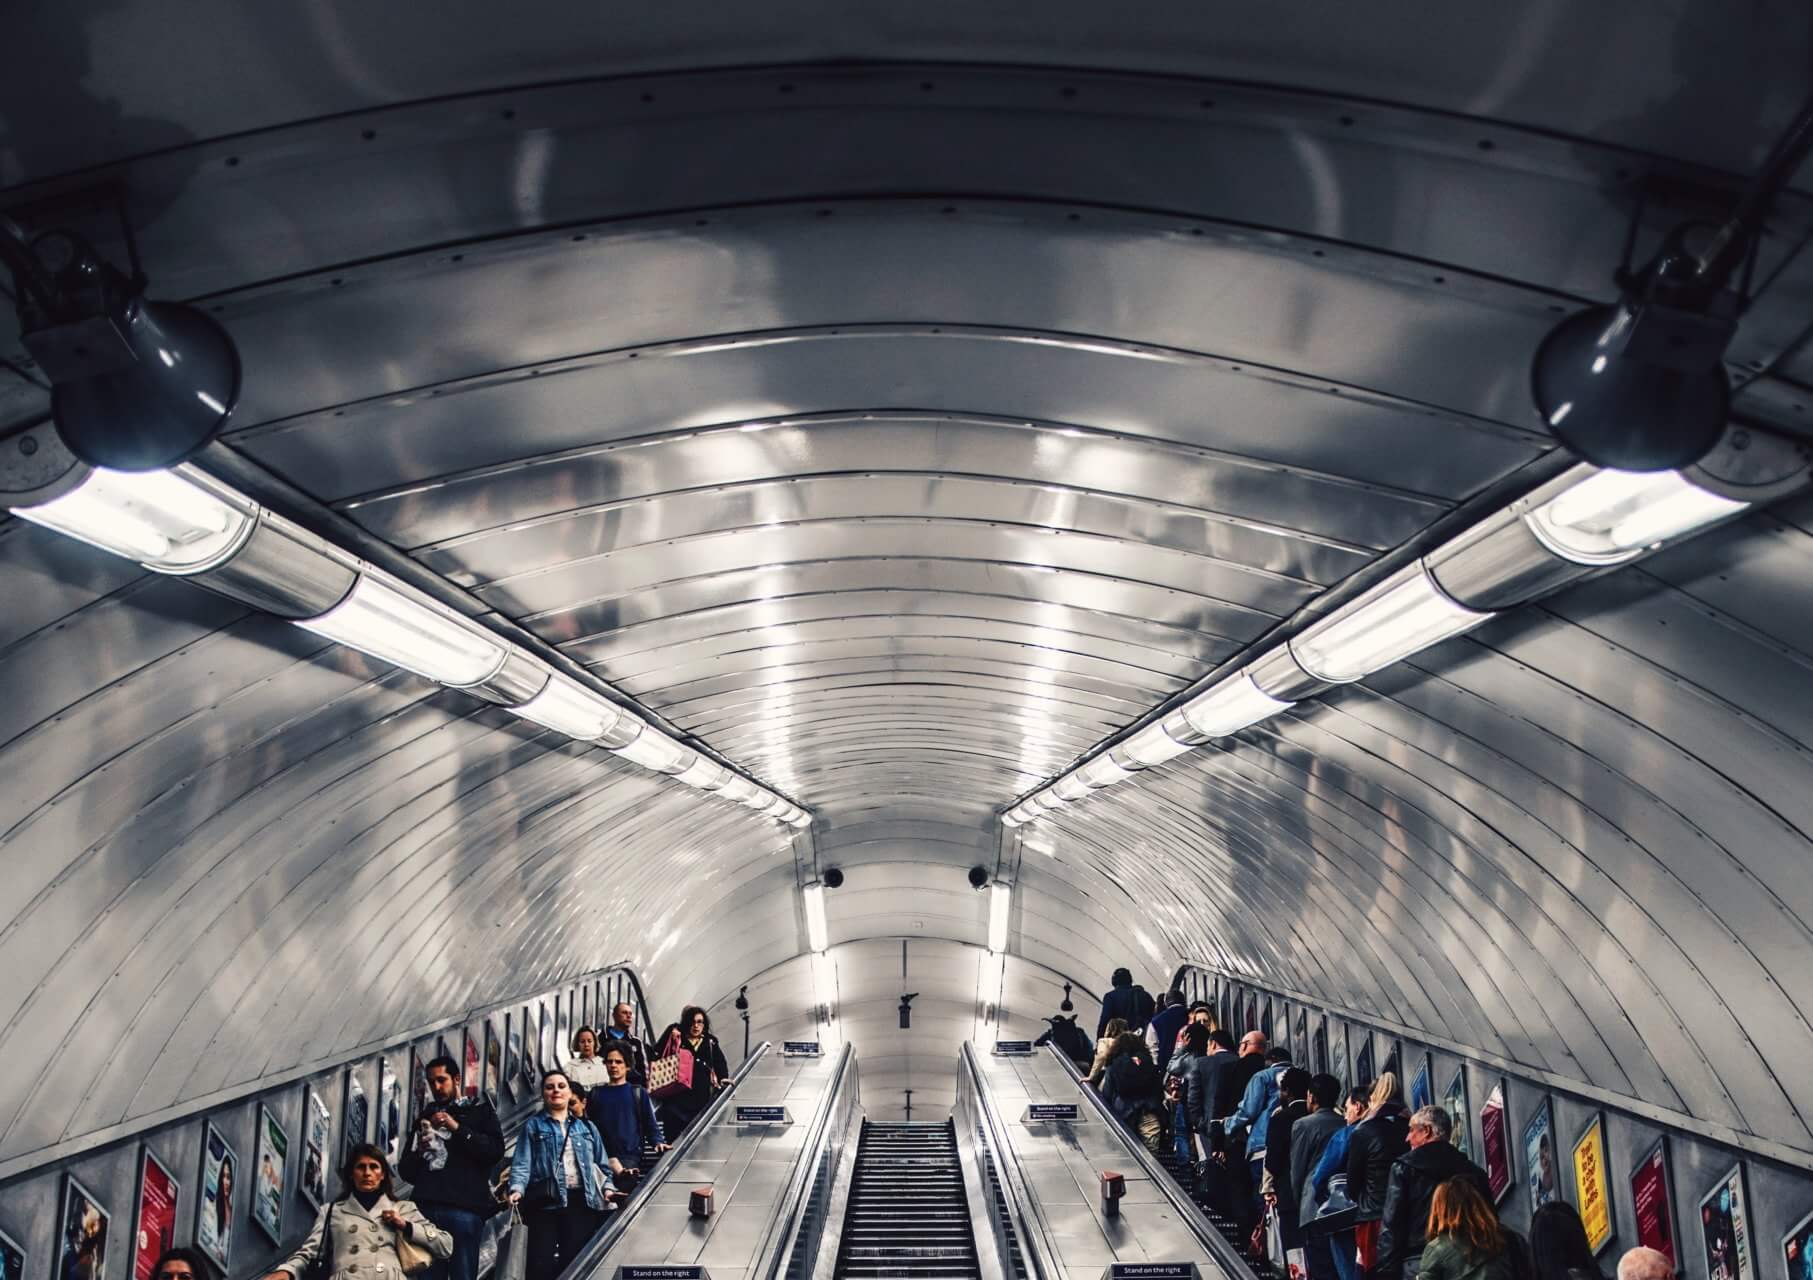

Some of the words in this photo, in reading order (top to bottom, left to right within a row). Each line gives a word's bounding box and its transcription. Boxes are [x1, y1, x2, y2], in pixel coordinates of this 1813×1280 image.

[632, 1269, 652, 1277] Stand
[662, 1269, 673, 1277] the
[674, 1269, 690, 1278] right
[1165, 1266, 1181, 1275] right
